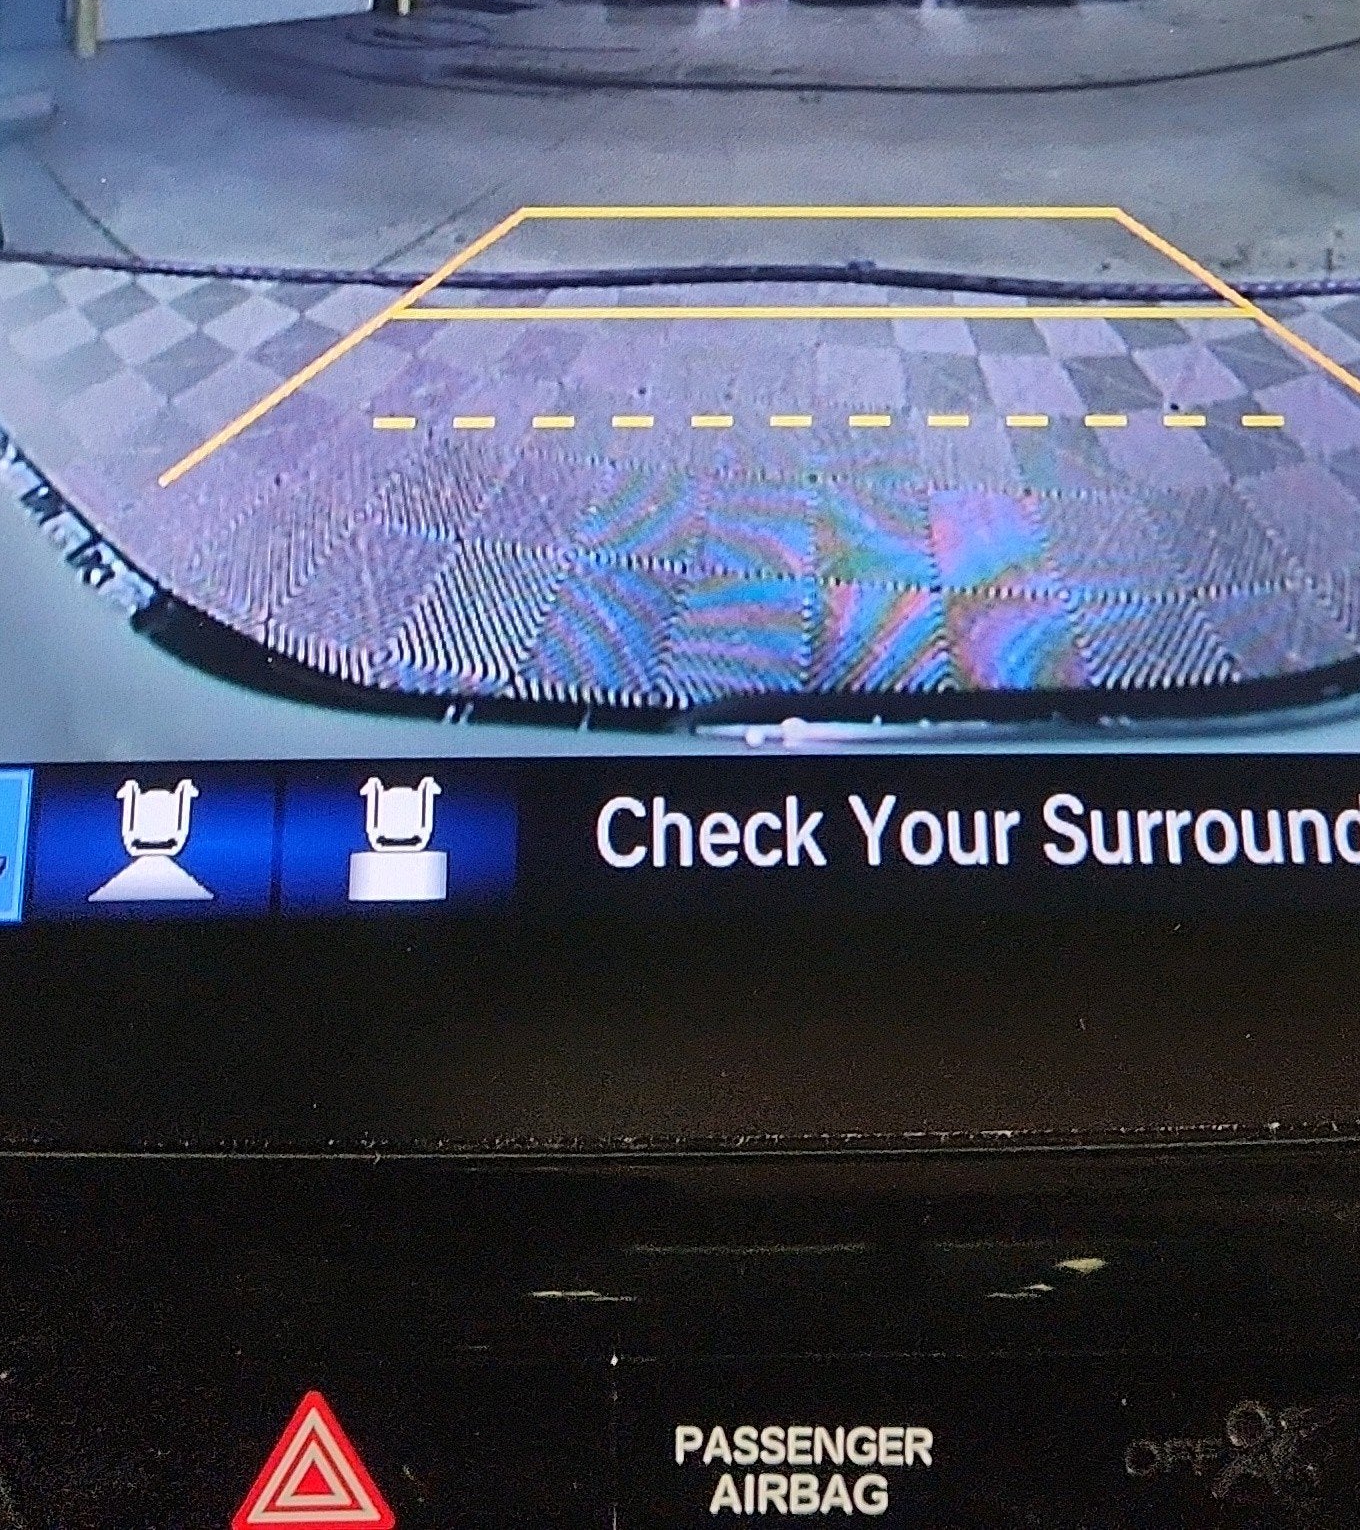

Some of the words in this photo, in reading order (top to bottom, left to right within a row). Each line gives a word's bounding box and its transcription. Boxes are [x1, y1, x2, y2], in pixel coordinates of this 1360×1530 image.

[594, 794, 828, 870] Check
[846, 792, 1024, 868] Your
[674, 1425, 934, 1466] PASSENGER
[709, 1473, 890, 1516] AIRBAG
